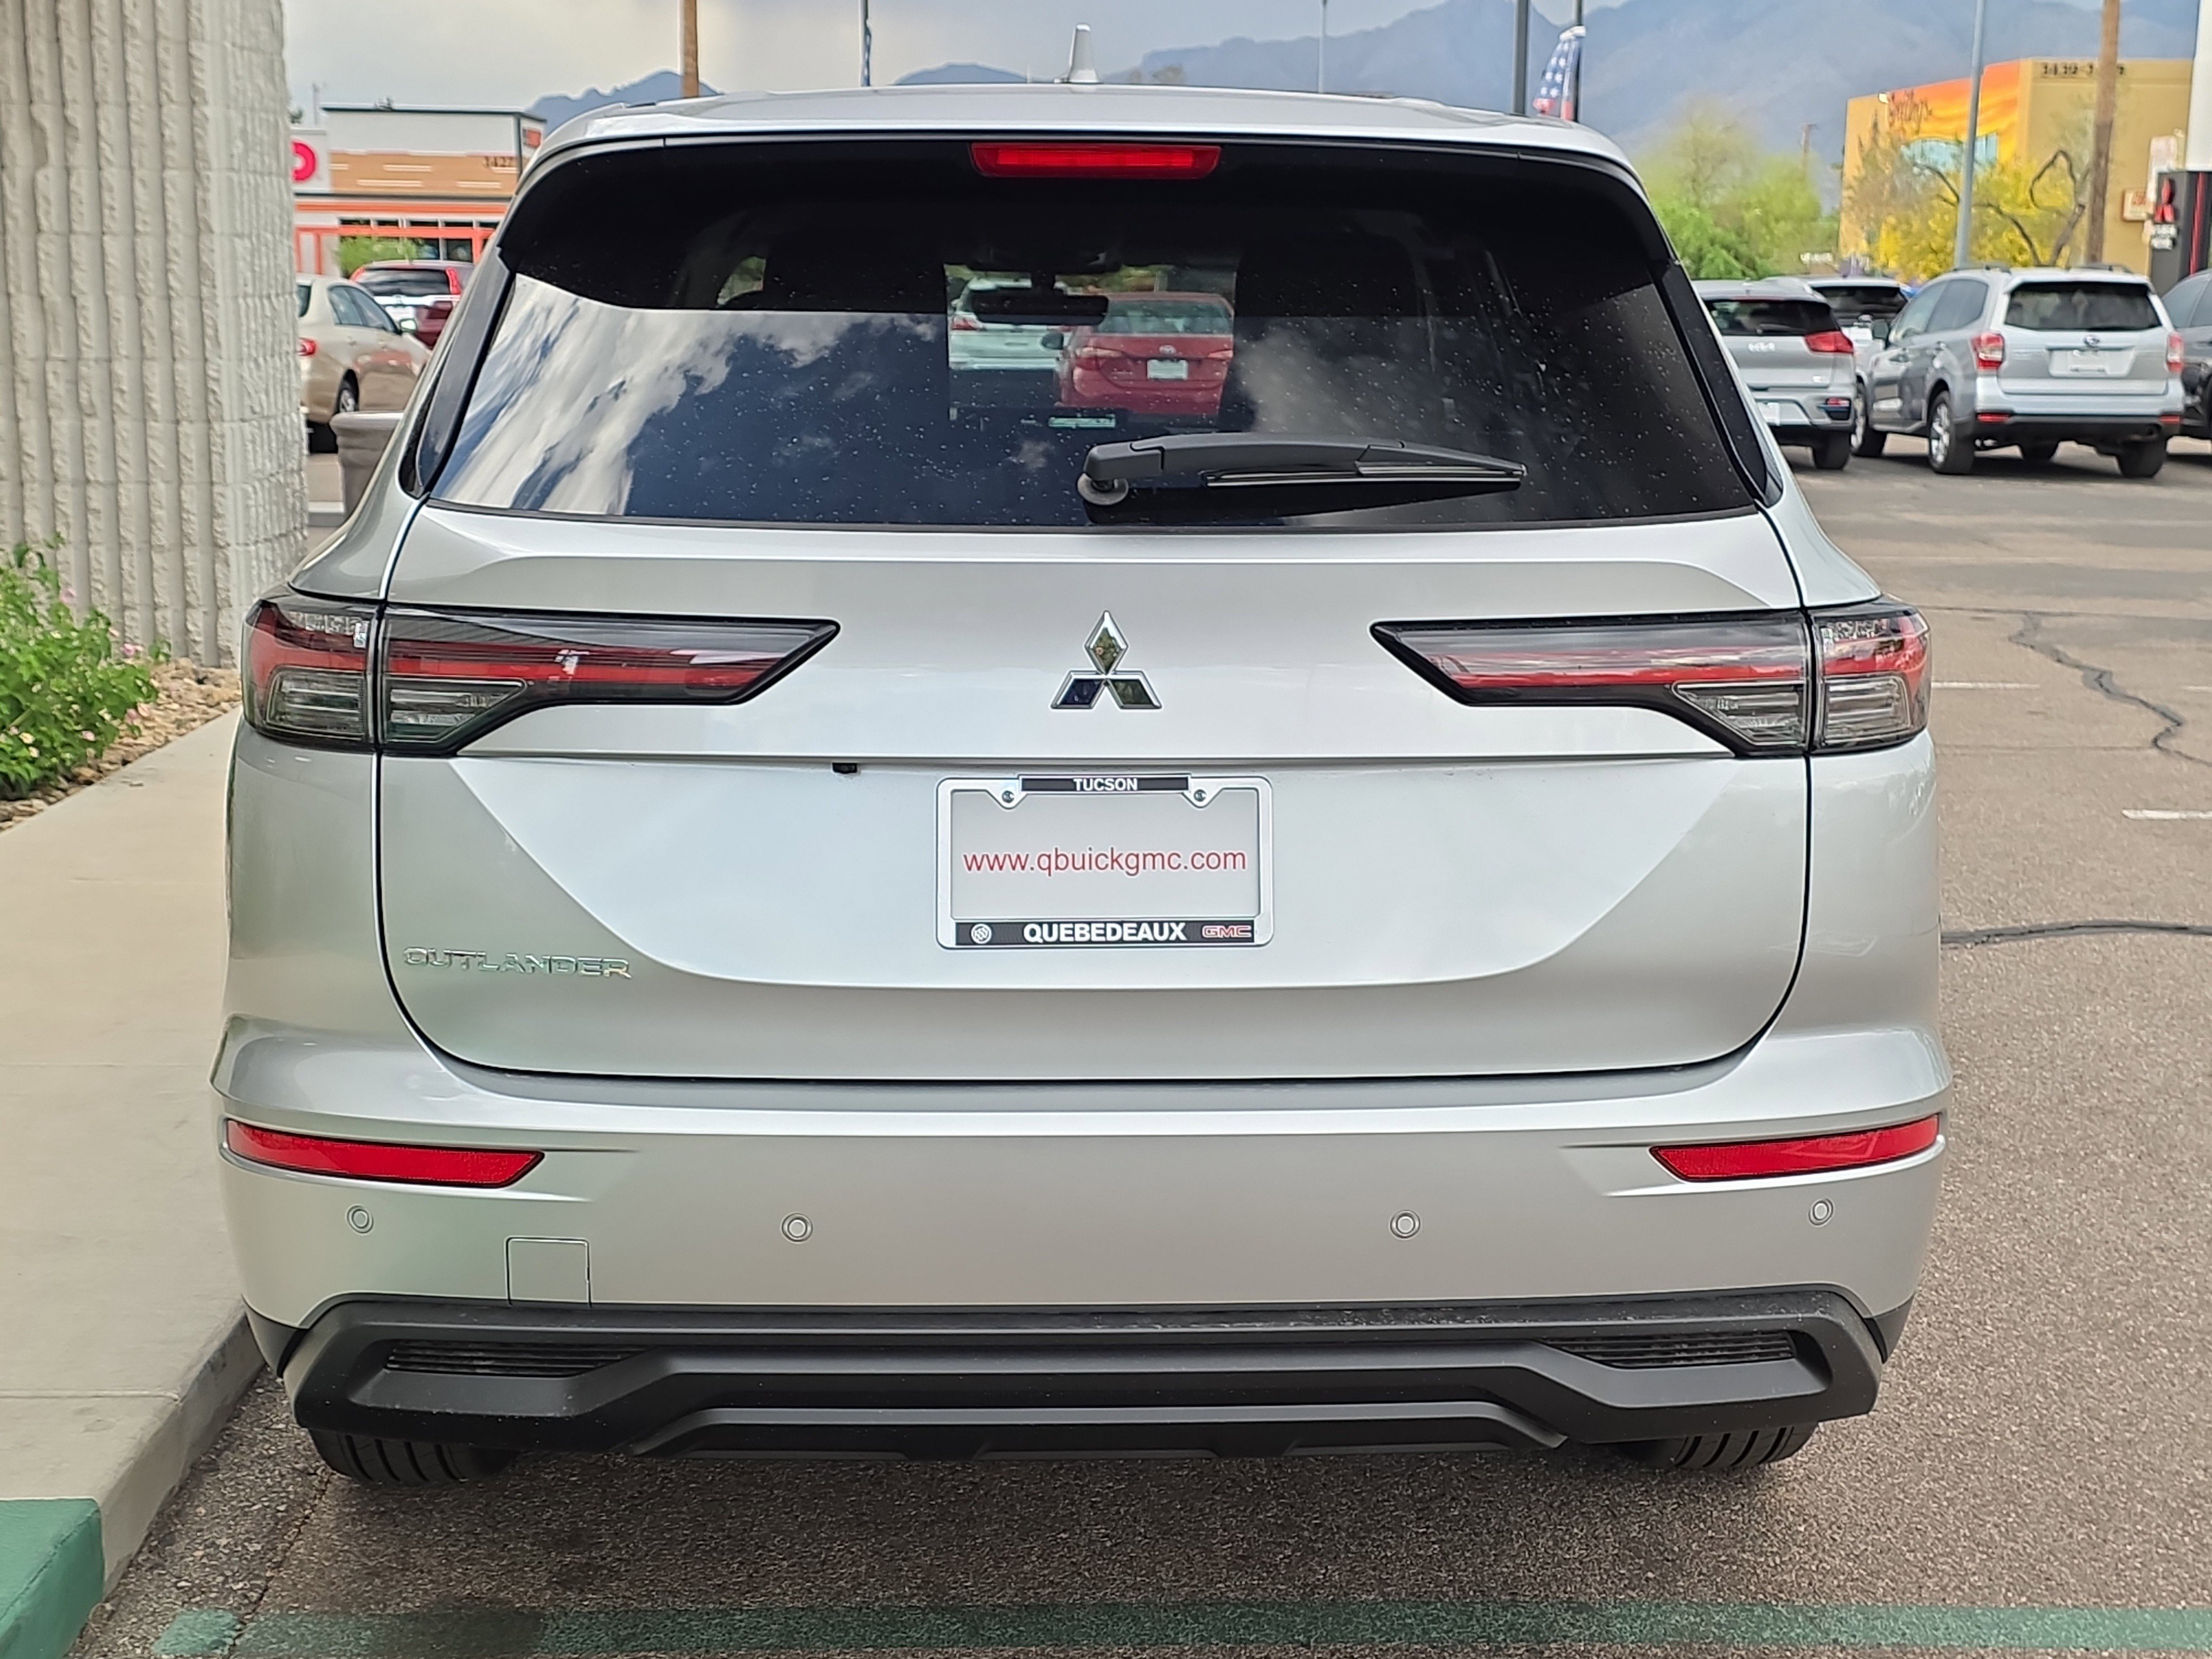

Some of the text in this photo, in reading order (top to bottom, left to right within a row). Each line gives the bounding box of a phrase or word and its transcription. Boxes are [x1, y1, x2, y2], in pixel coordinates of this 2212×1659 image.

[1073, 778, 1138, 791] TUCSON
[962, 846, 1247, 876] www.qbuickgmc.com
[1023, 923, 1252, 943] QUEBEDEAUX GMC
[403, 946, 632, 980] OUTLANDER
